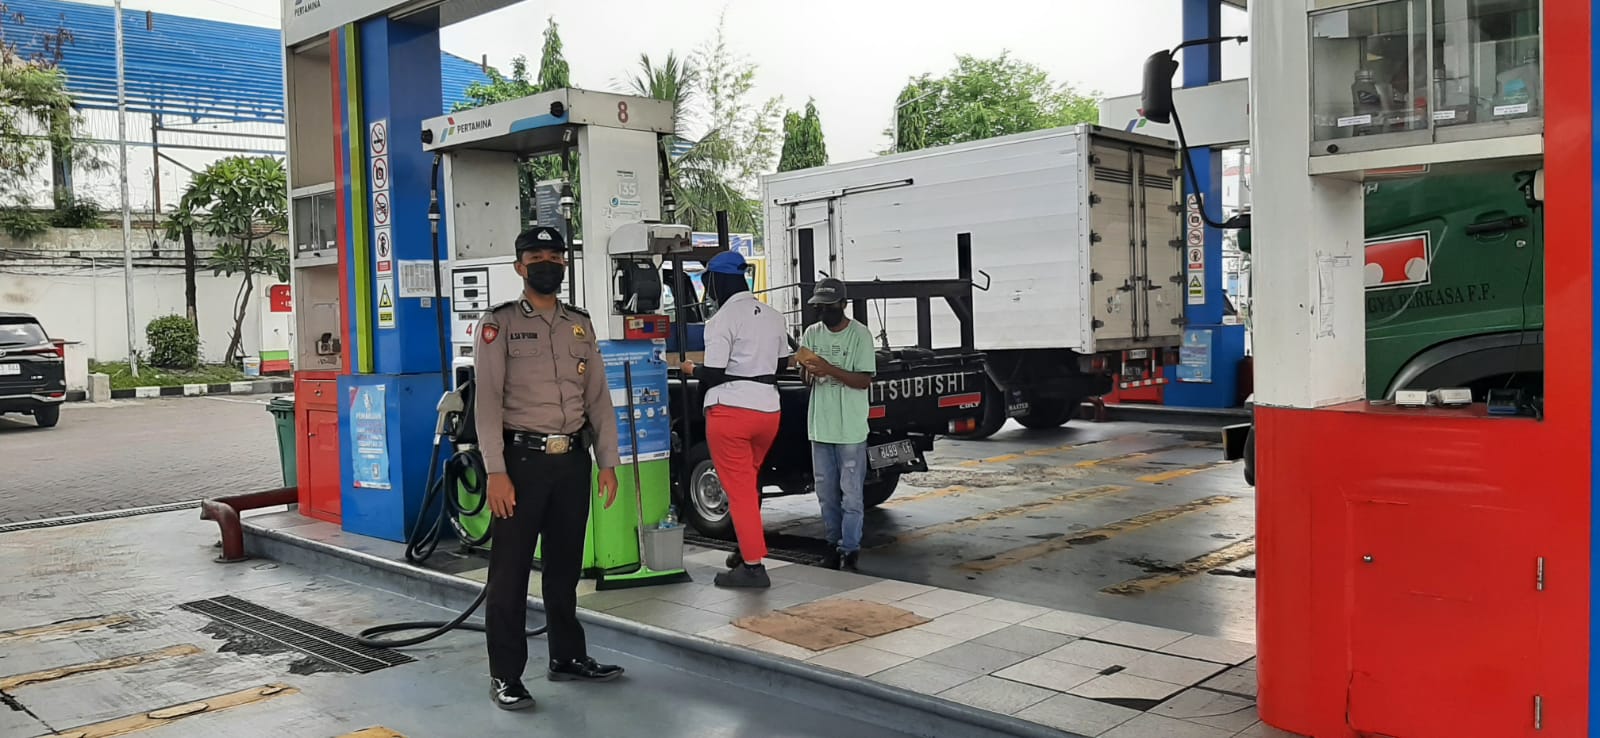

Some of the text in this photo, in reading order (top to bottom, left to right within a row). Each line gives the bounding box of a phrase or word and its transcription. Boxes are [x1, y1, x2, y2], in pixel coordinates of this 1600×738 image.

[617, 101, 629, 124] 8
[457, 117, 493, 135] PERTAMINA
[1367, 296, 1398, 314] GYA
[1399, 287, 1465, 310] PERKASA
[465, 323, 474, 336] 4
[870, 372, 965, 403] ITSUBISHI
